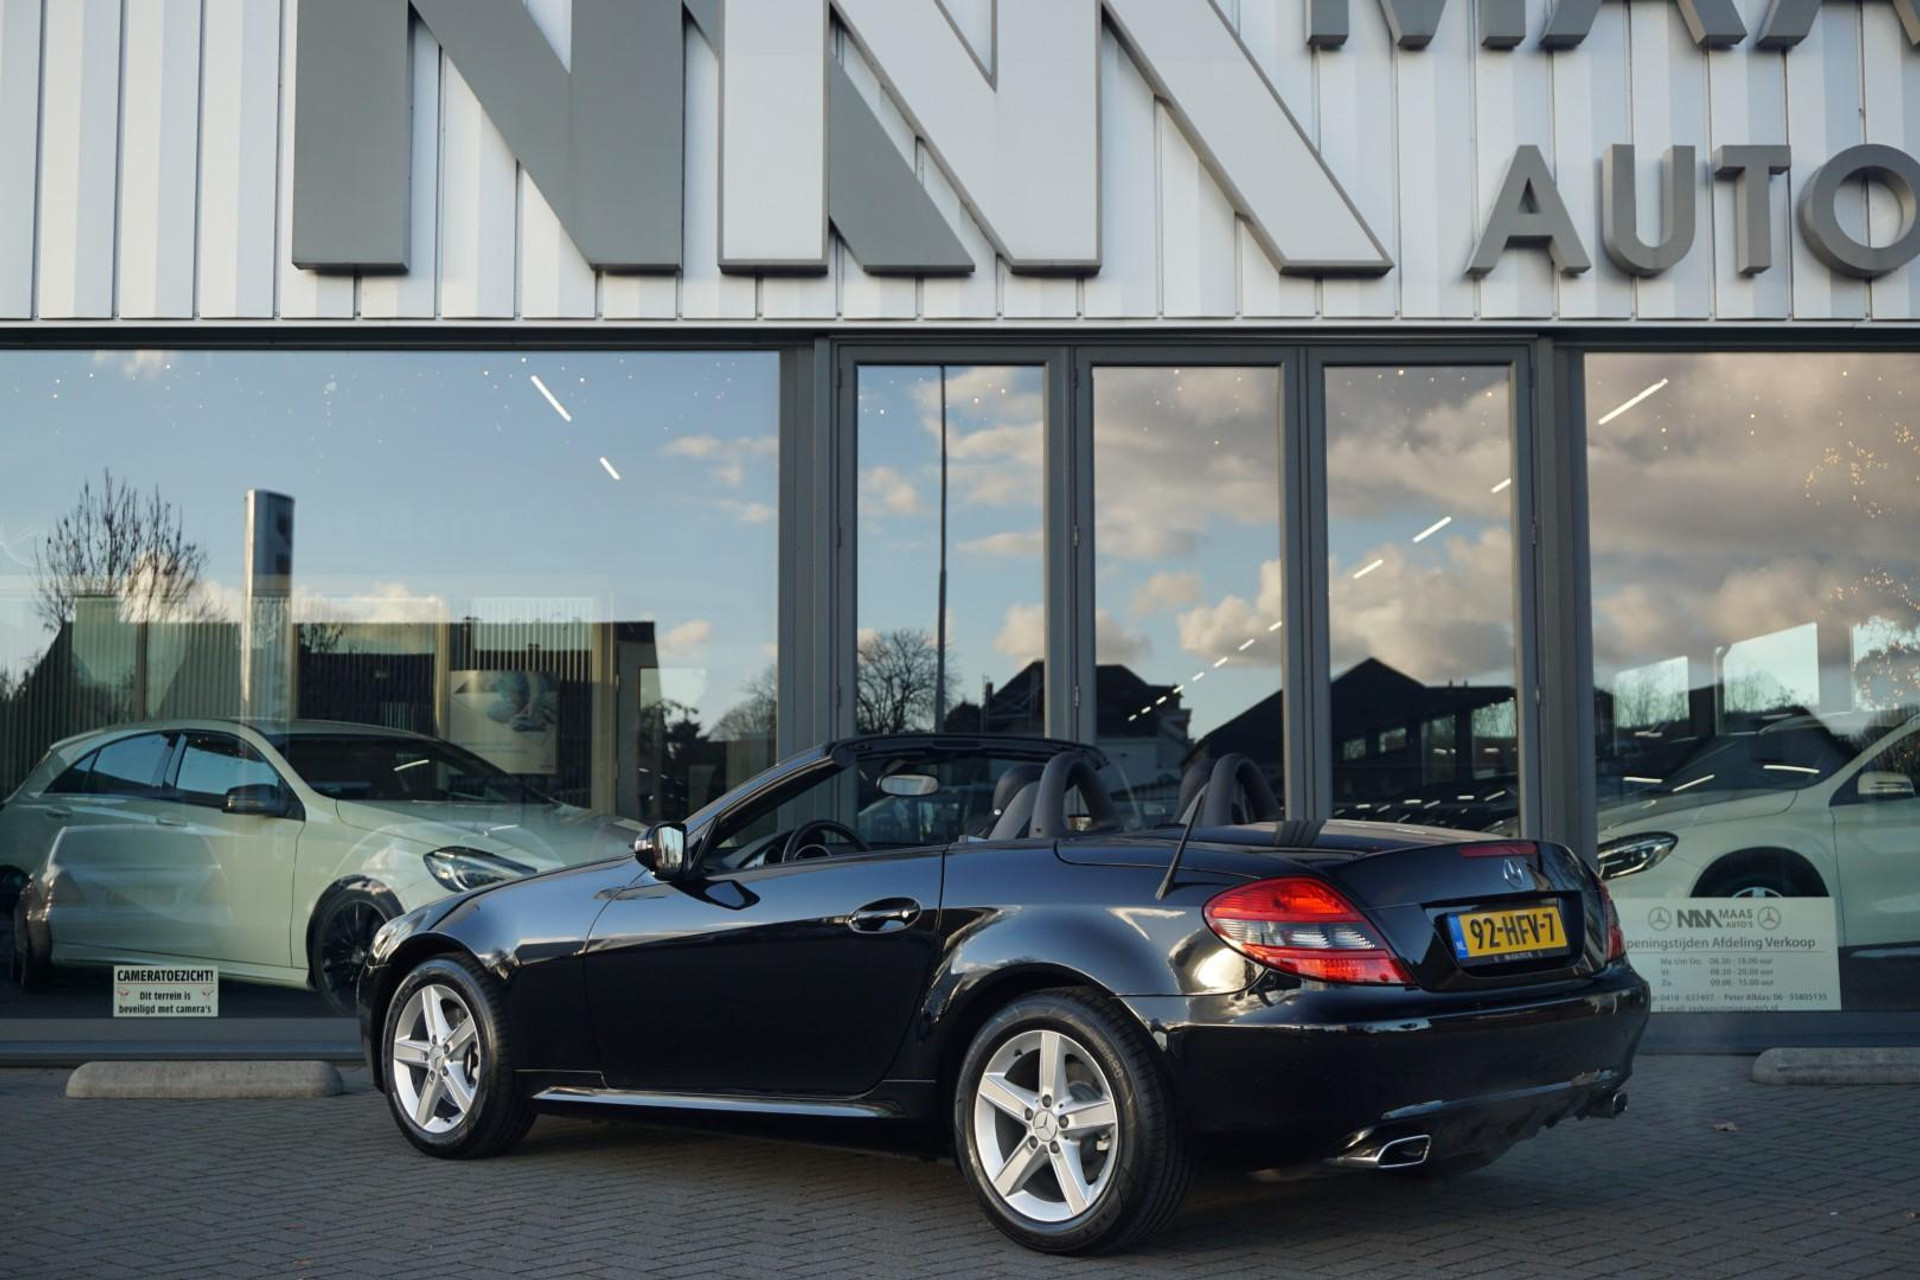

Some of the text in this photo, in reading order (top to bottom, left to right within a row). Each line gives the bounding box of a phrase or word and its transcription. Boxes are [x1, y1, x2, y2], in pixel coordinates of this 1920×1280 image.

[1719, 909, 1753, 919] MAAS
[1469, 912, 1556, 950] 92-HFV-7
[1625, 936, 1816, 951] peningstijden Afdeling Verkoop
[117, 969, 214, 982] CAMERATOEZICHT!
[140, 991, 191, 1000] Dit terrein is
[119, 1004, 211, 1015] beveiligd met camera's
